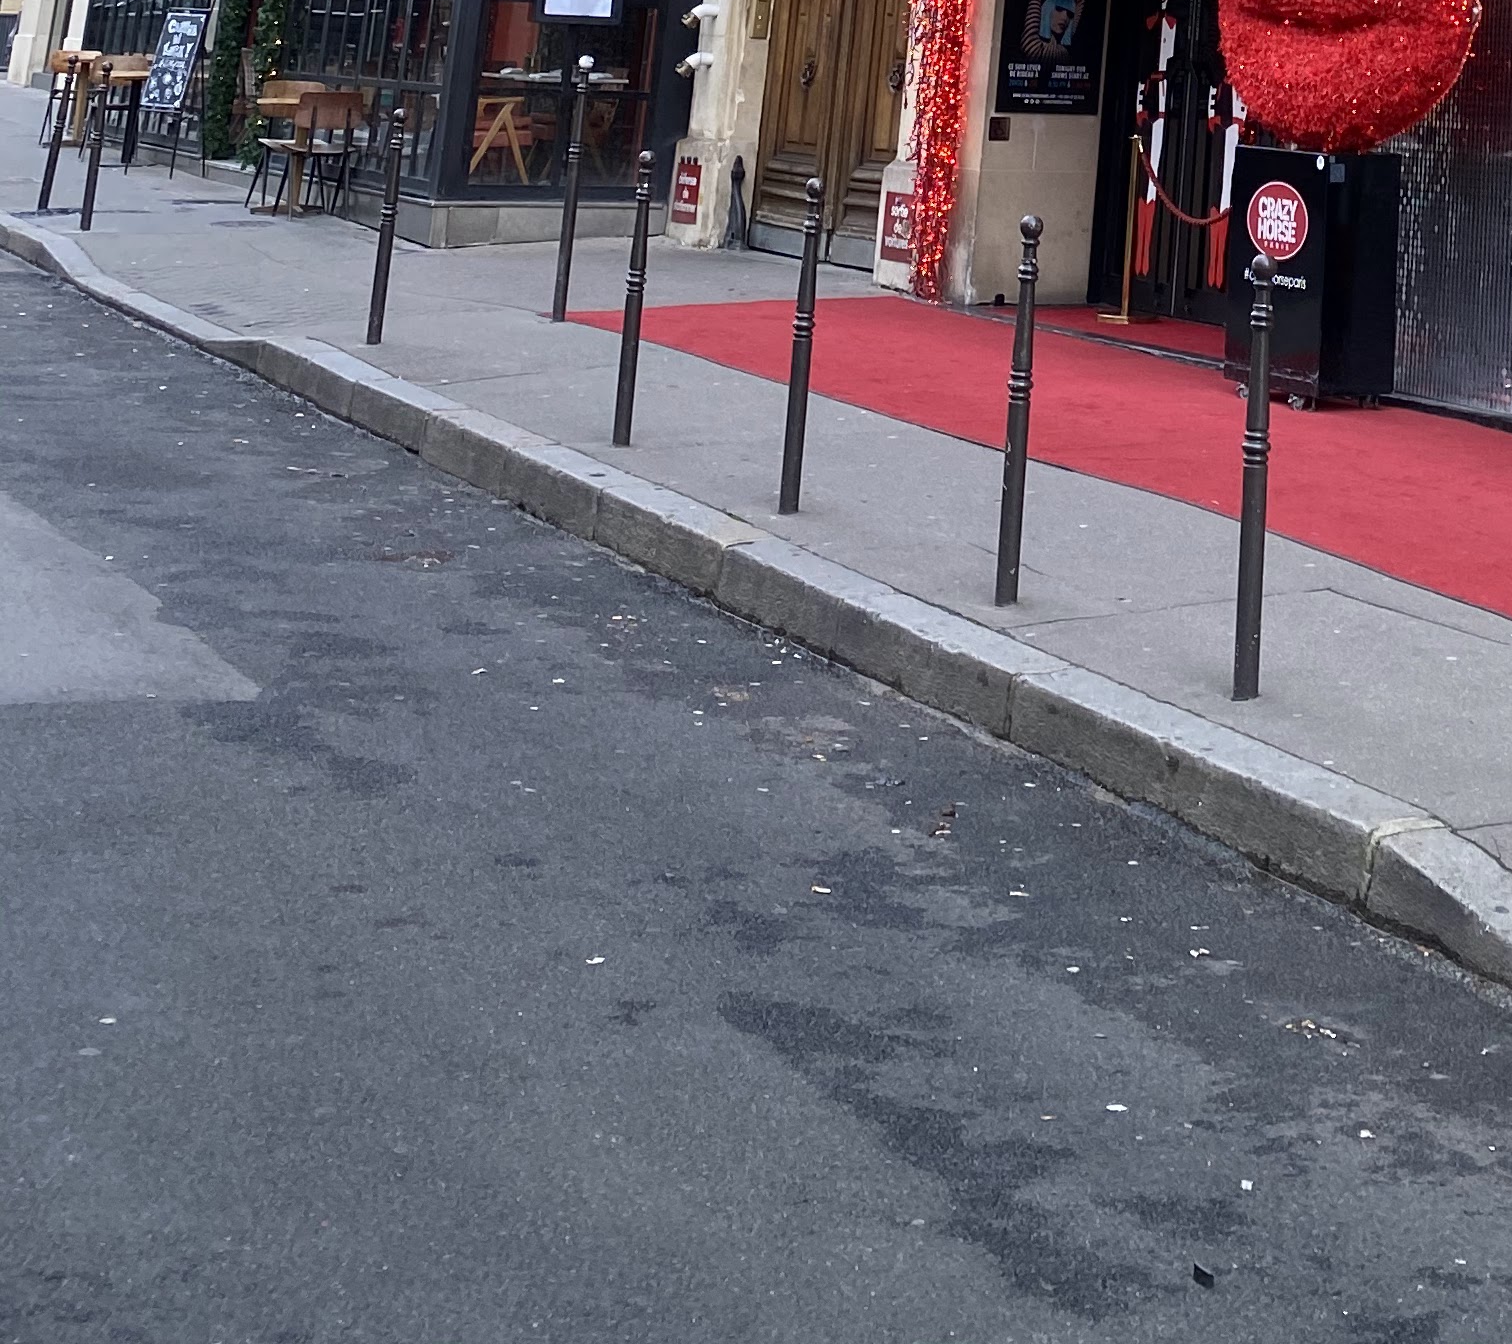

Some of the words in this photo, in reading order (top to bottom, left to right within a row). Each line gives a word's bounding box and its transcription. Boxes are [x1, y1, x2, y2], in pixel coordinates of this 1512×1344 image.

[1258, 196, 1298, 221] CRAZY
[1257, 217, 1297, 244] HORSE
[1244, 267, 1306, 290] #corseparis
